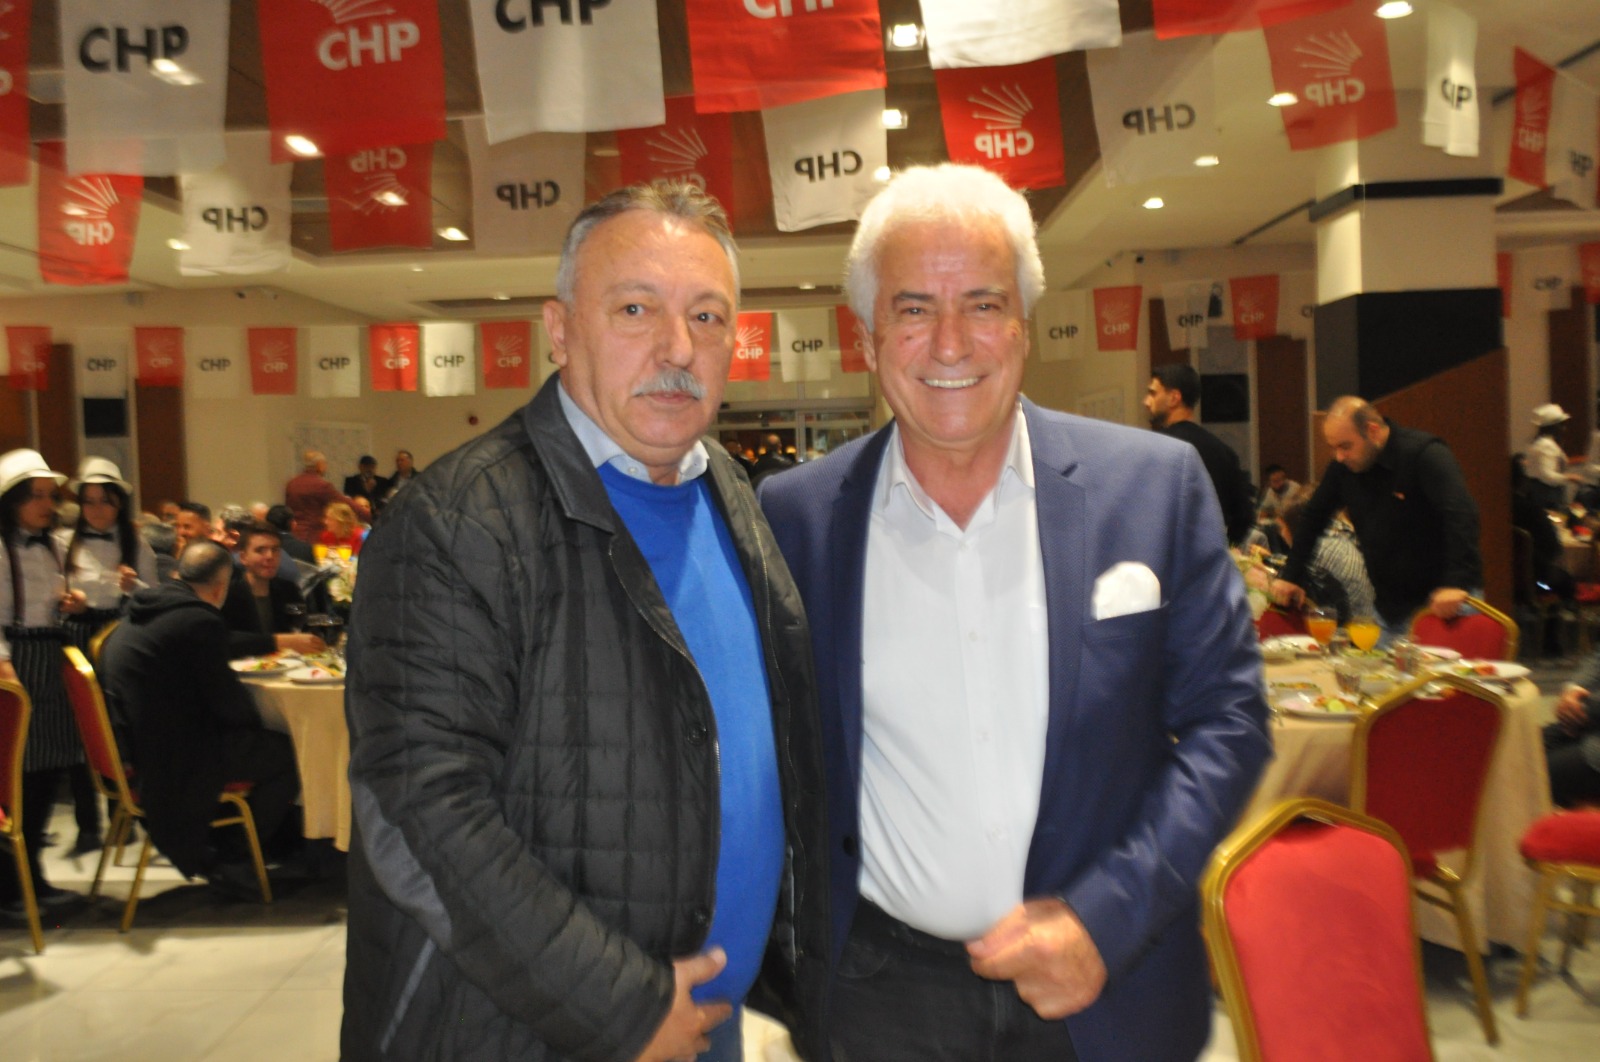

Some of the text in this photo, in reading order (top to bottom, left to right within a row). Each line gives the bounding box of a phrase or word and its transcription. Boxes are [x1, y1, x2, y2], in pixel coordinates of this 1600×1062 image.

[79, 24, 190, 73] CHP
[318, 21, 420, 70] CHP
[1049, 325, 1079, 340] CHP
[1104, 323, 1130, 335] CHP
[736, 347, 763, 359] CHP
[792, 340, 823, 353] CHP
[86, 357, 117, 372] CHP
[199, 357, 232, 372] CHP
[262, 361, 289, 374] CHP
[319, 356, 351, 371] CHP
[384, 355, 411, 370] CHP
[432, 354, 466, 369] CHP
[497, 355, 523, 369] CHP
